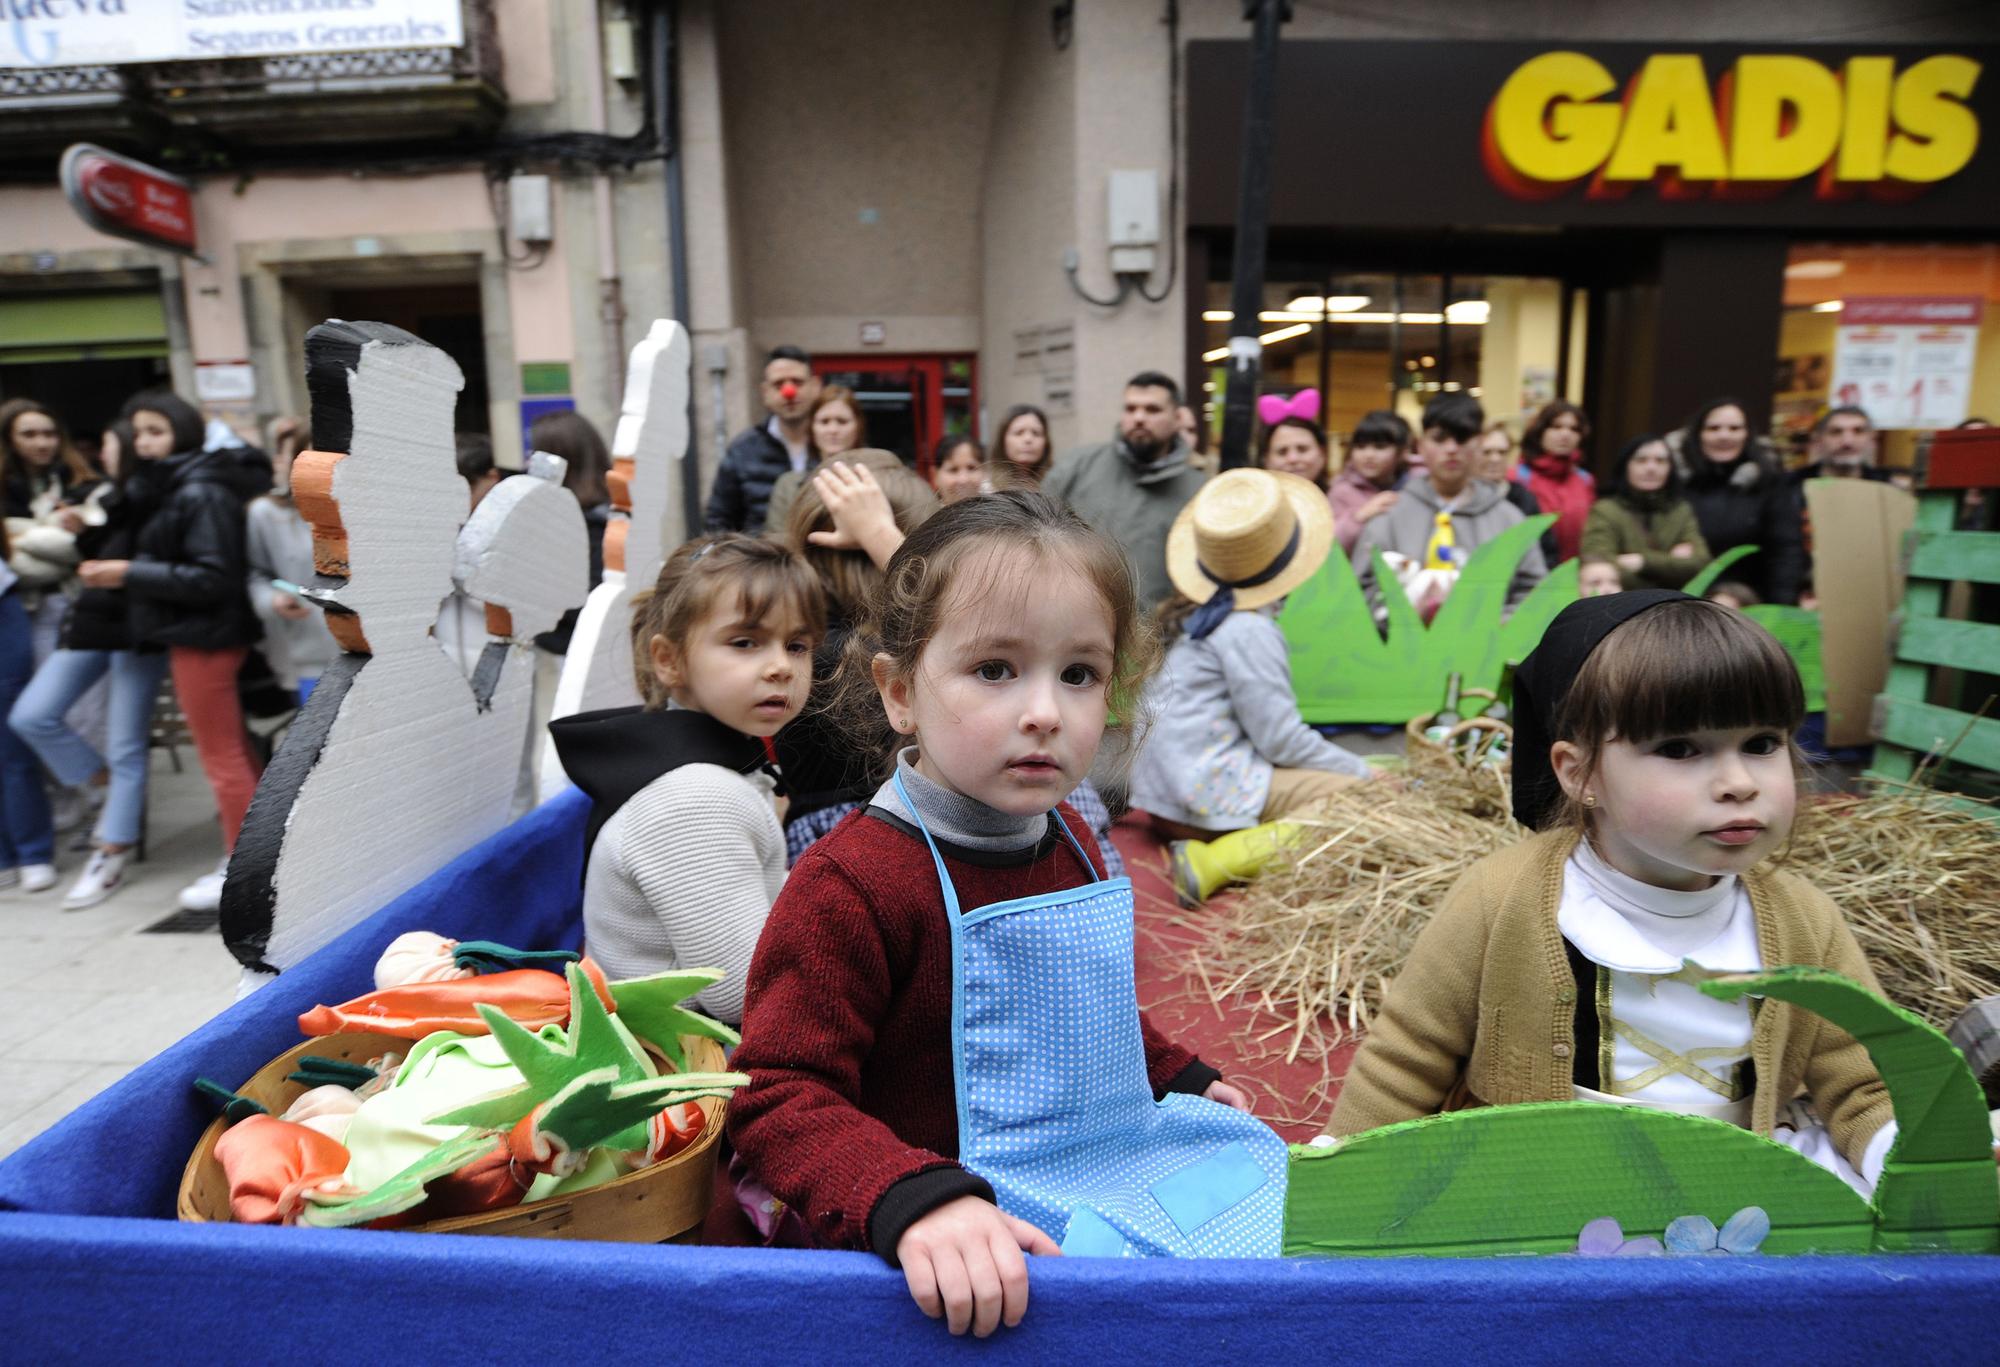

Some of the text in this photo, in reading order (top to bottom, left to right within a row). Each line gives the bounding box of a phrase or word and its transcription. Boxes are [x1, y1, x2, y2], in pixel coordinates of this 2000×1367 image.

[188, 31, 298, 55] Seguros
[307, 18, 446, 46] Generales
[1494, 51, 1984, 182] GADIS
